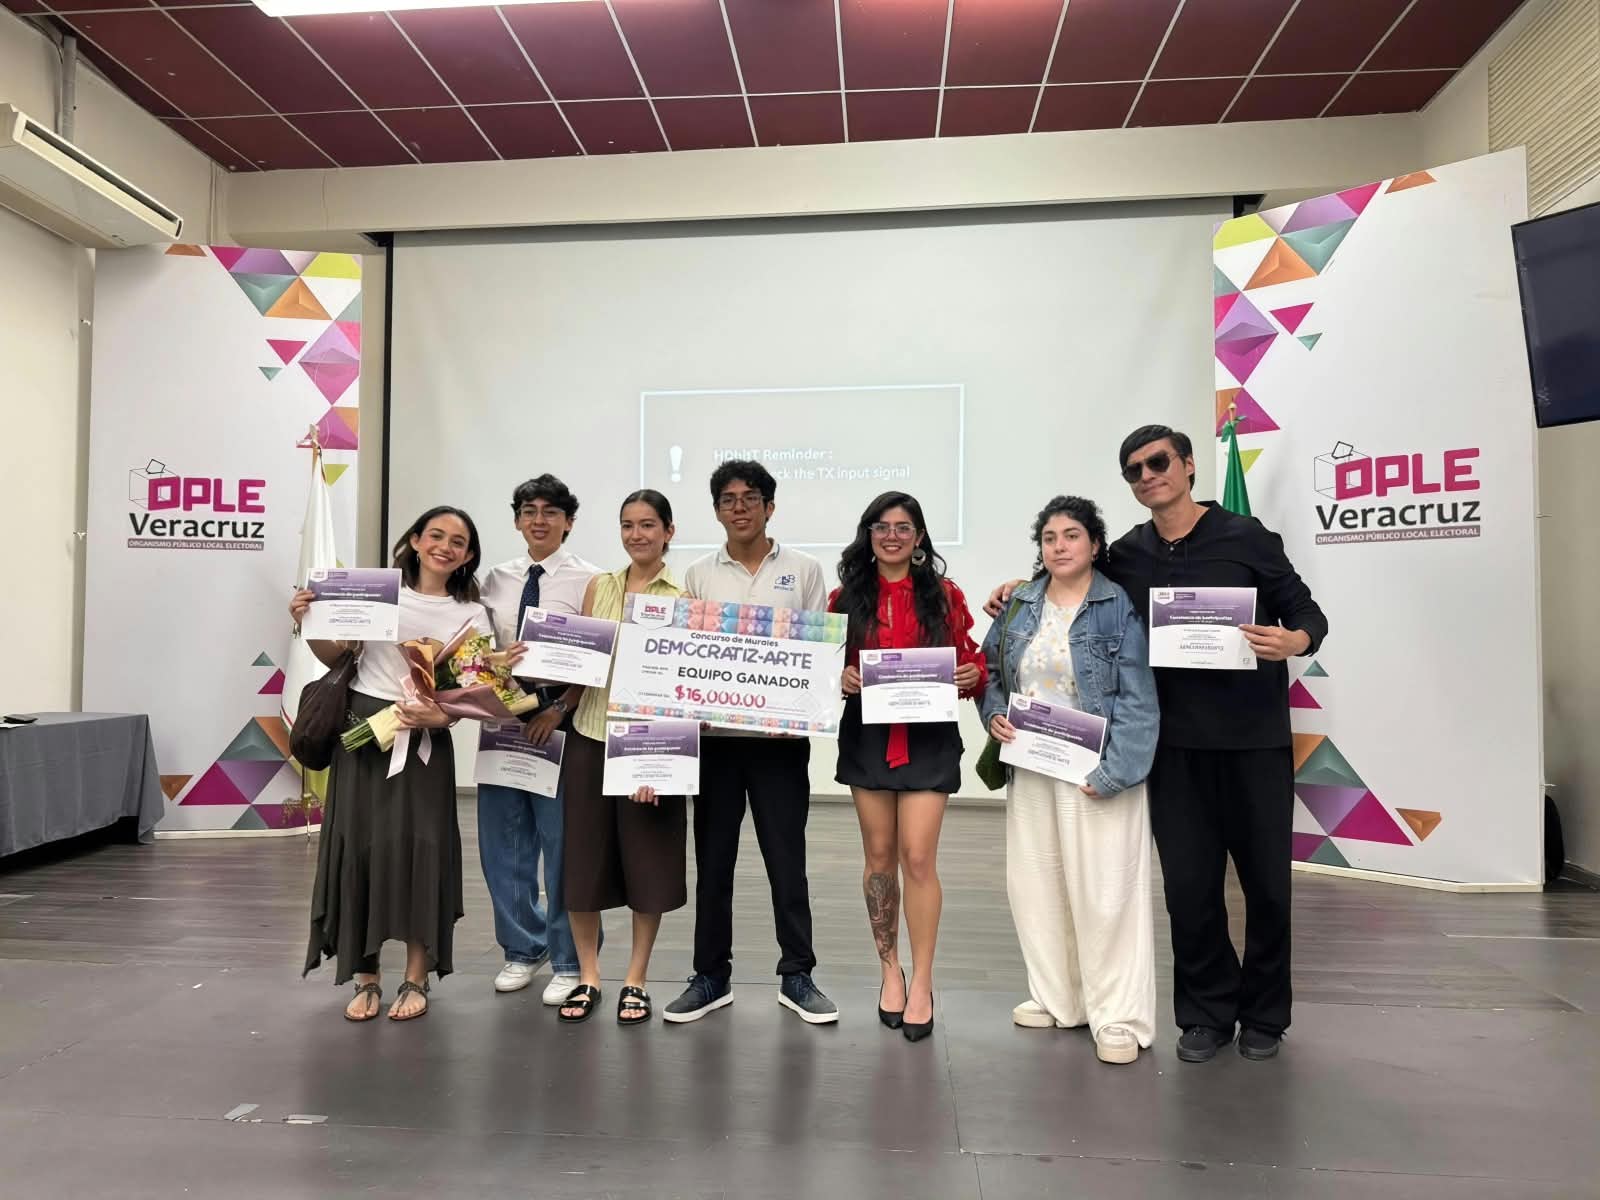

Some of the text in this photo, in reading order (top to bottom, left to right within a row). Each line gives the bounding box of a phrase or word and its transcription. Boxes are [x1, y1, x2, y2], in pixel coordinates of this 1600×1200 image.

[794, 465, 815, 479] the
[816, 466, 835, 479] TX
[837, 465, 869, 480] input
[871, 464, 911, 480] signal
[1335, 448, 1481, 501] OPLE
[148, 476, 266, 513] OPLE
[129, 513, 265, 538] Veracruz
[1315, 501, 1481, 530] Veracruz
[128, 540, 171, 548] ORGANISMO
[225, 542, 262, 550] ELECTORAL
[1316, 534, 1365, 544] ORGANISMO
[1401, 530, 1428, 539] LOCAL
[1430, 528, 1479, 538] ELECTORAL
[691, 632, 731, 643] Concurso
[745, 637, 779, 647] Murales
[645, 638, 812, 670] DEMOCRATIZ-ARTE
[678, 667, 732, 682] EQUIPO
[737, 672, 810, 689] GANADOR
[675, 684, 766, 709] $16,000.00
